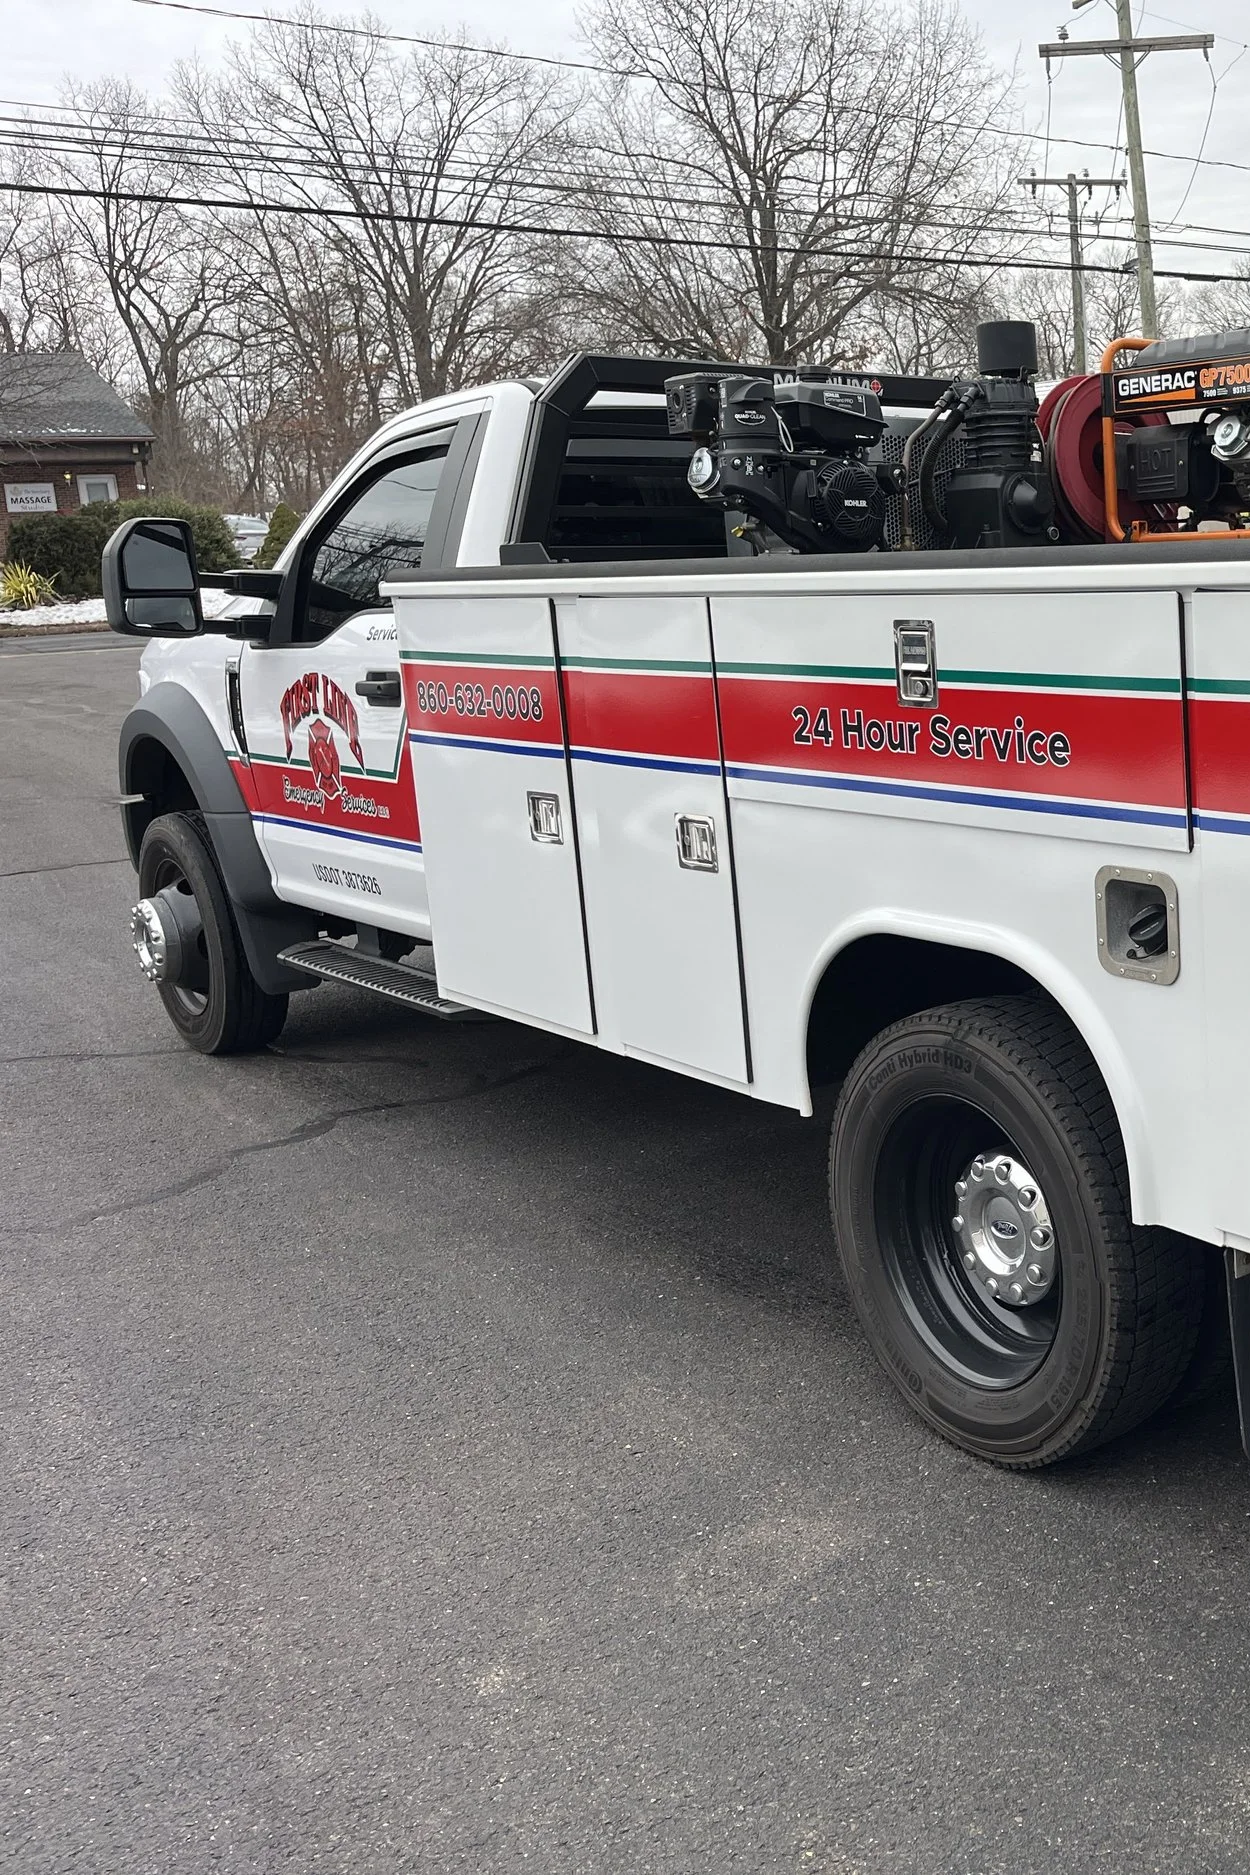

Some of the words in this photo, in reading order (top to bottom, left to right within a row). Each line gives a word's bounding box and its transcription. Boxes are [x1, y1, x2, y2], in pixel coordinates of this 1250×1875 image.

[1118, 371, 1195, 396] GENERAC
[10, 496, 52, 504] MASSAGE
[844, 499, 868, 508] KOHLER
[416, 680, 544, 723] 860-632-0008
[280, 672, 319, 763] FIRST
[321, 673, 367, 775] LINE
[791, 706, 833, 747] 24
[840, 708, 921, 754] Hour
[929, 714, 1071, 767] Service
[283, 775, 325, 814] Emergency
[340, 786, 377, 817] Services
[312, 863, 344, 886] USDOT
[342, 870, 382, 895] 3873626
[869, 1060, 897, 1090] Conti
[898, 1048, 940, 1069] Hybrid
